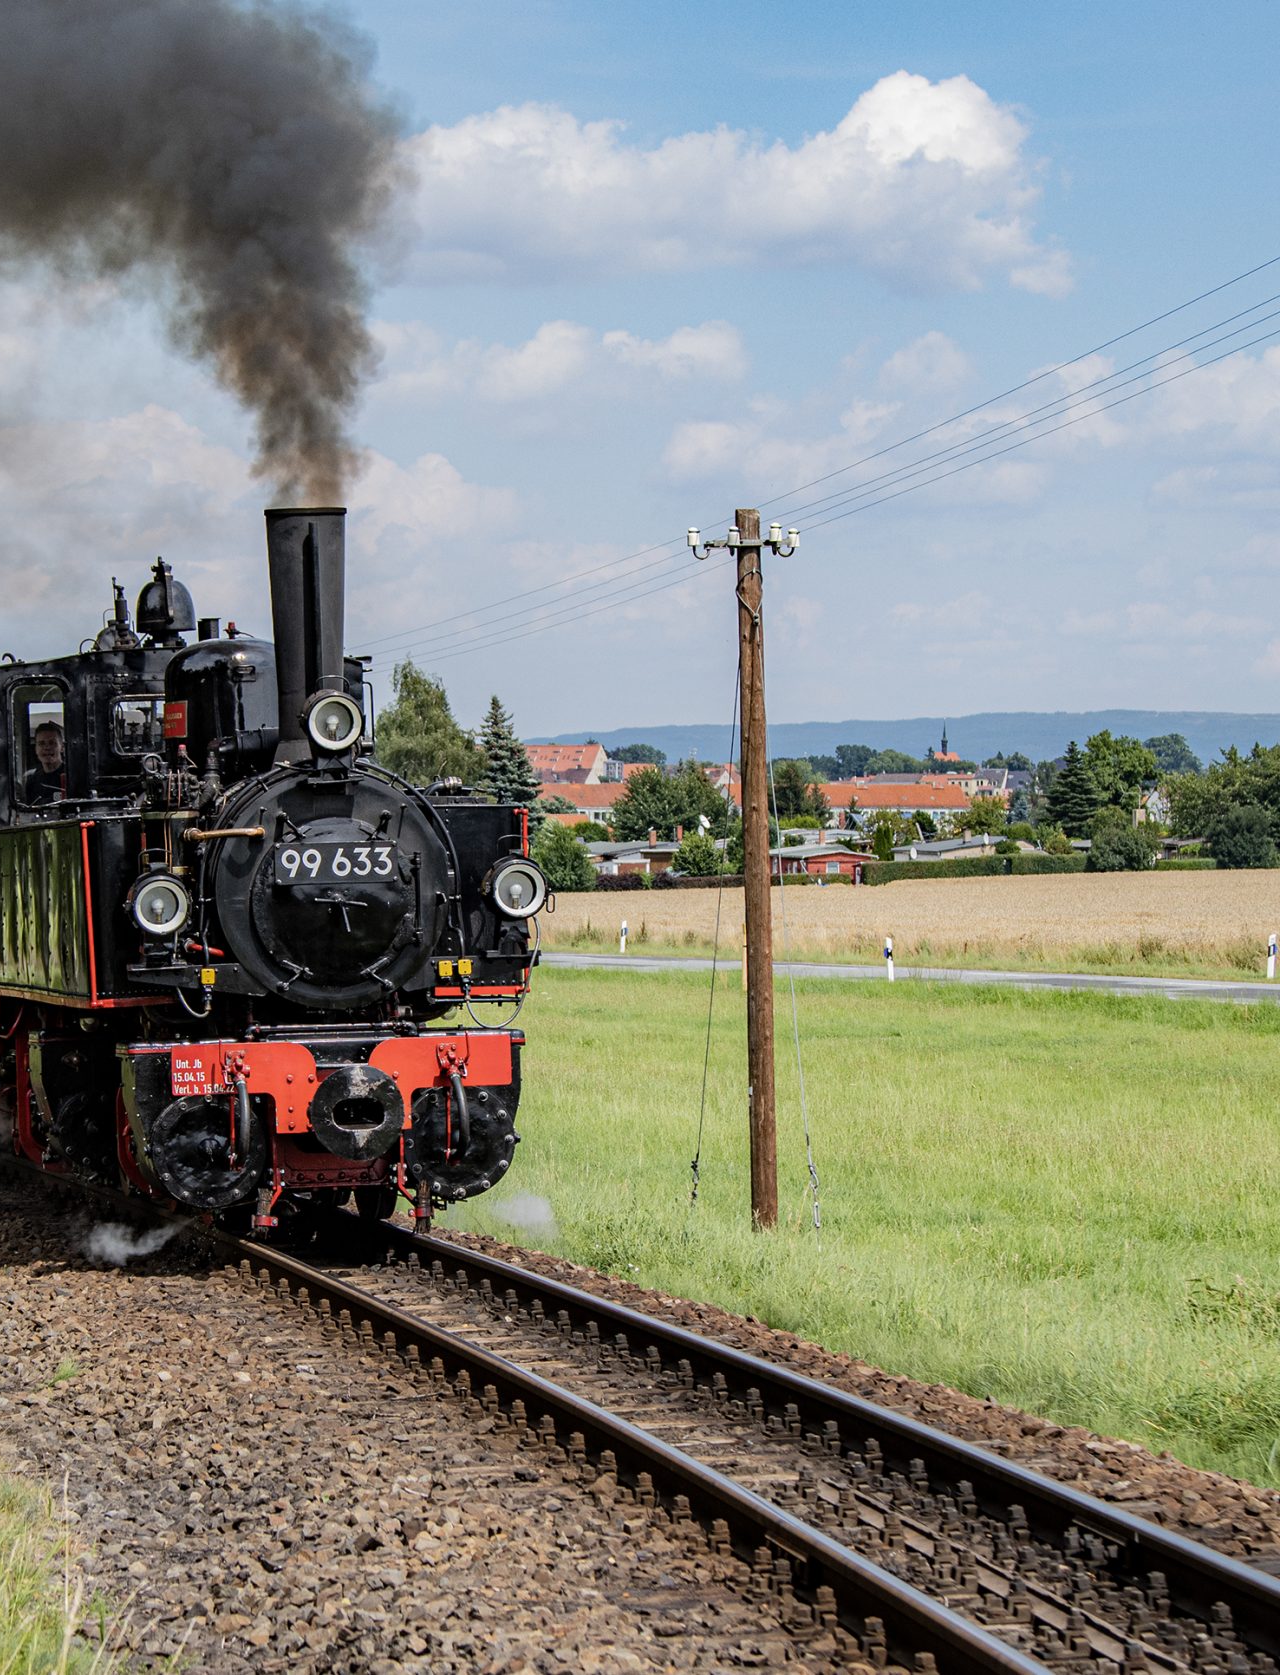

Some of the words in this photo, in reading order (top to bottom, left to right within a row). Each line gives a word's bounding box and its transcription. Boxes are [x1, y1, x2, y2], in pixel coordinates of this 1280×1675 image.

[281, 849, 322, 878] 99
[332, 847, 393, 877] 633
[175, 1059, 191, 1069] Unt.
[193, 1059, 202, 1069] Jb
[173, 1072, 206, 1082] 15.04.15
[194, 1084, 202, 1094] b.
